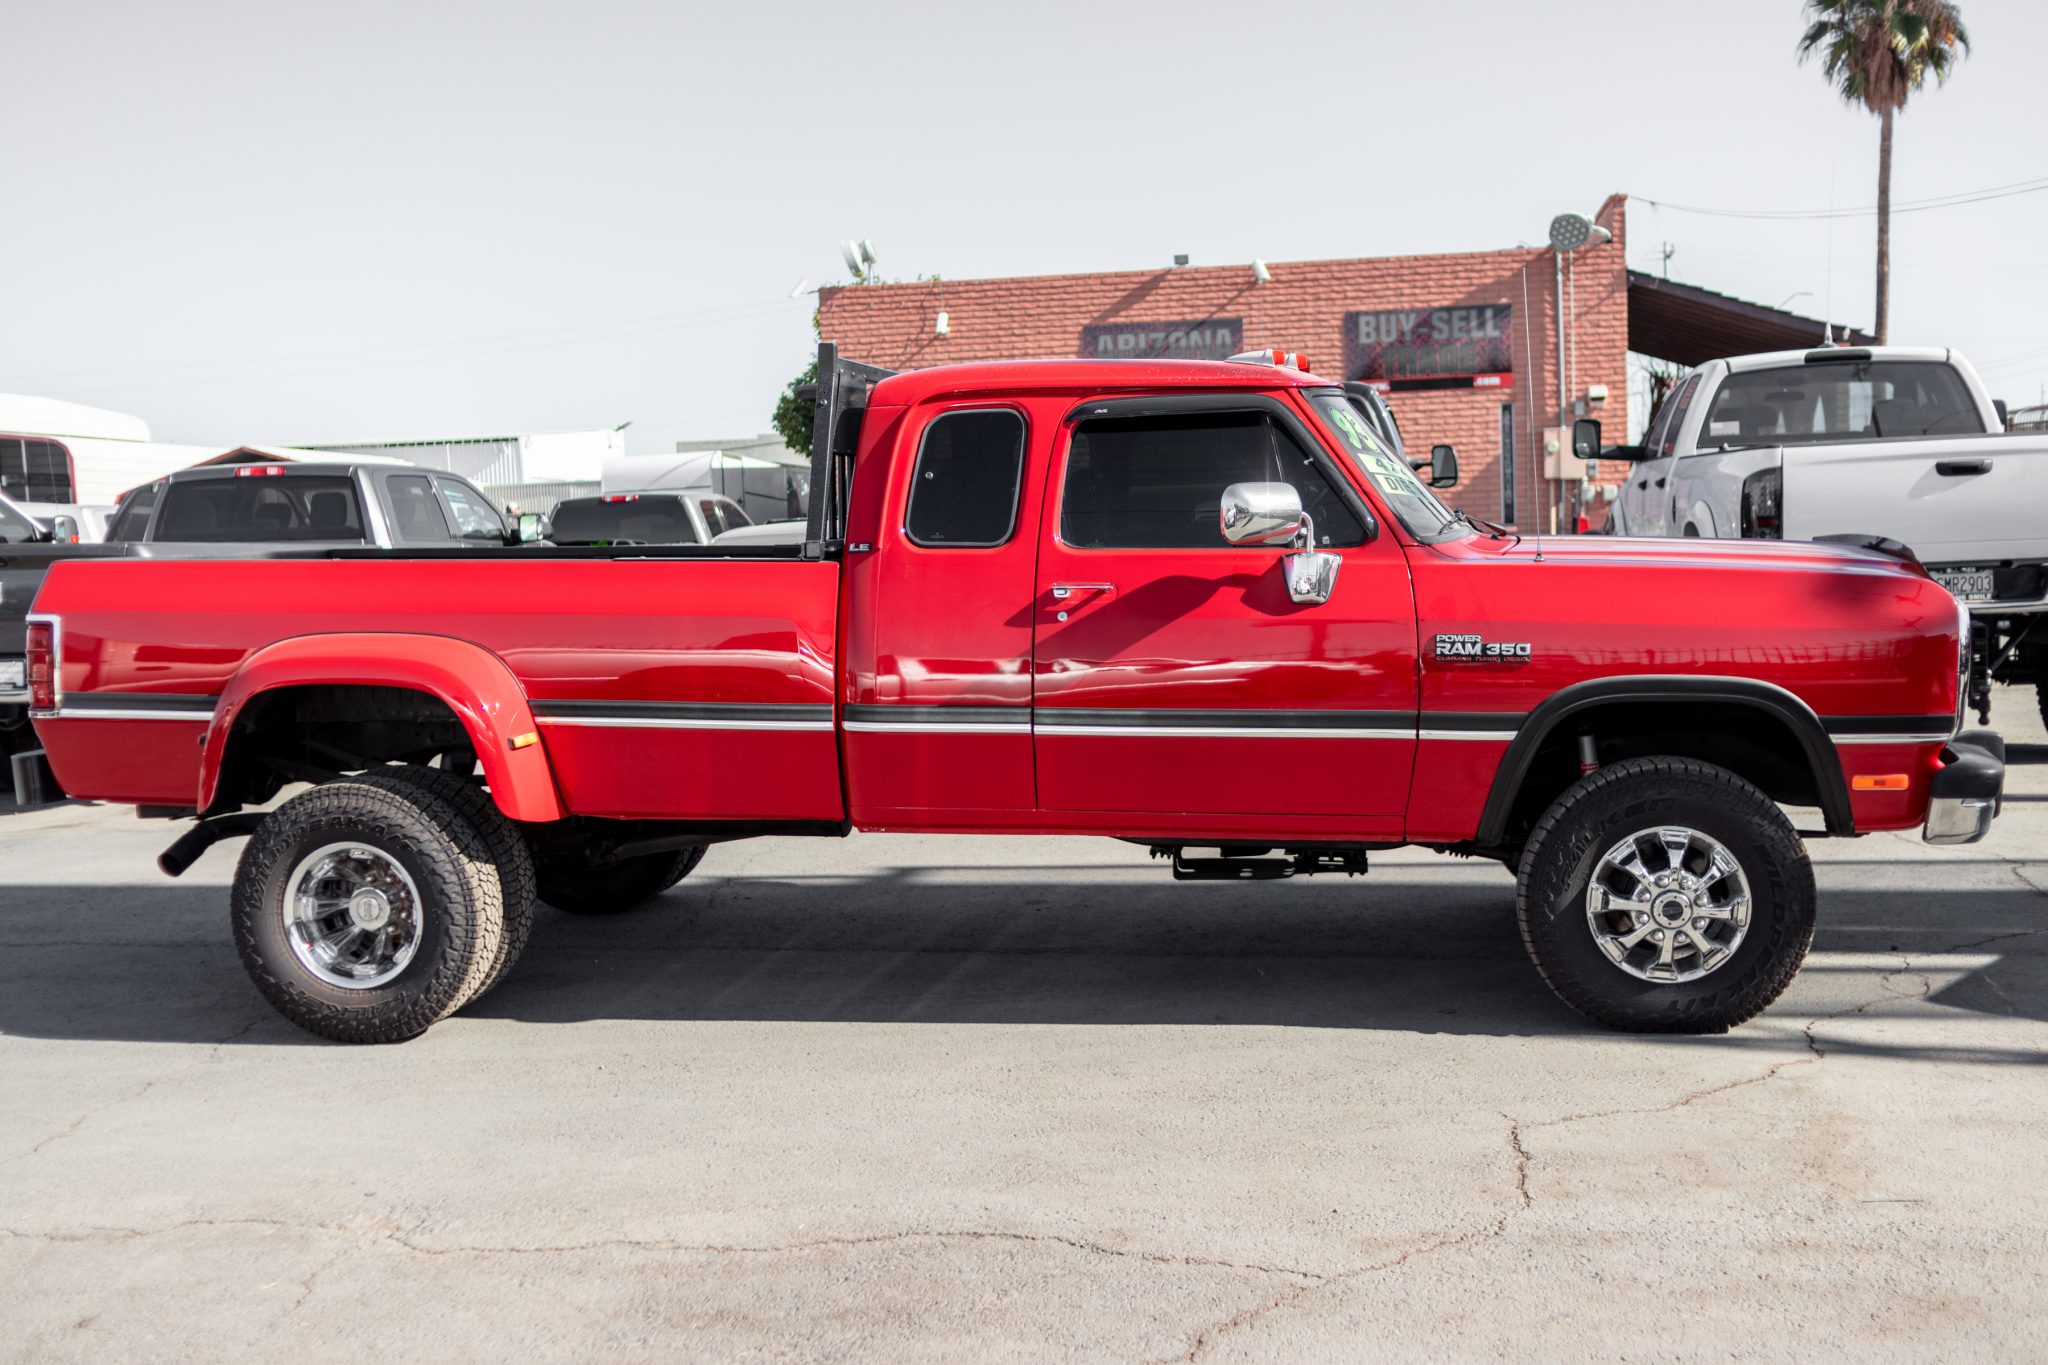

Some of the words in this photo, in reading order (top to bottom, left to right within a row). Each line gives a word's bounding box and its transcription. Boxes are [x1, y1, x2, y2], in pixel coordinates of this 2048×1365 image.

[1096, 328, 1233, 359] ARIZONA
[1382, 343, 1477, 376] TRADE
[848, 542, 870, 552] LE
[1436, 634, 1482, 642] POWER
[1436, 643, 1482, 655] RAM
[1486, 643, 1531, 655] 350
